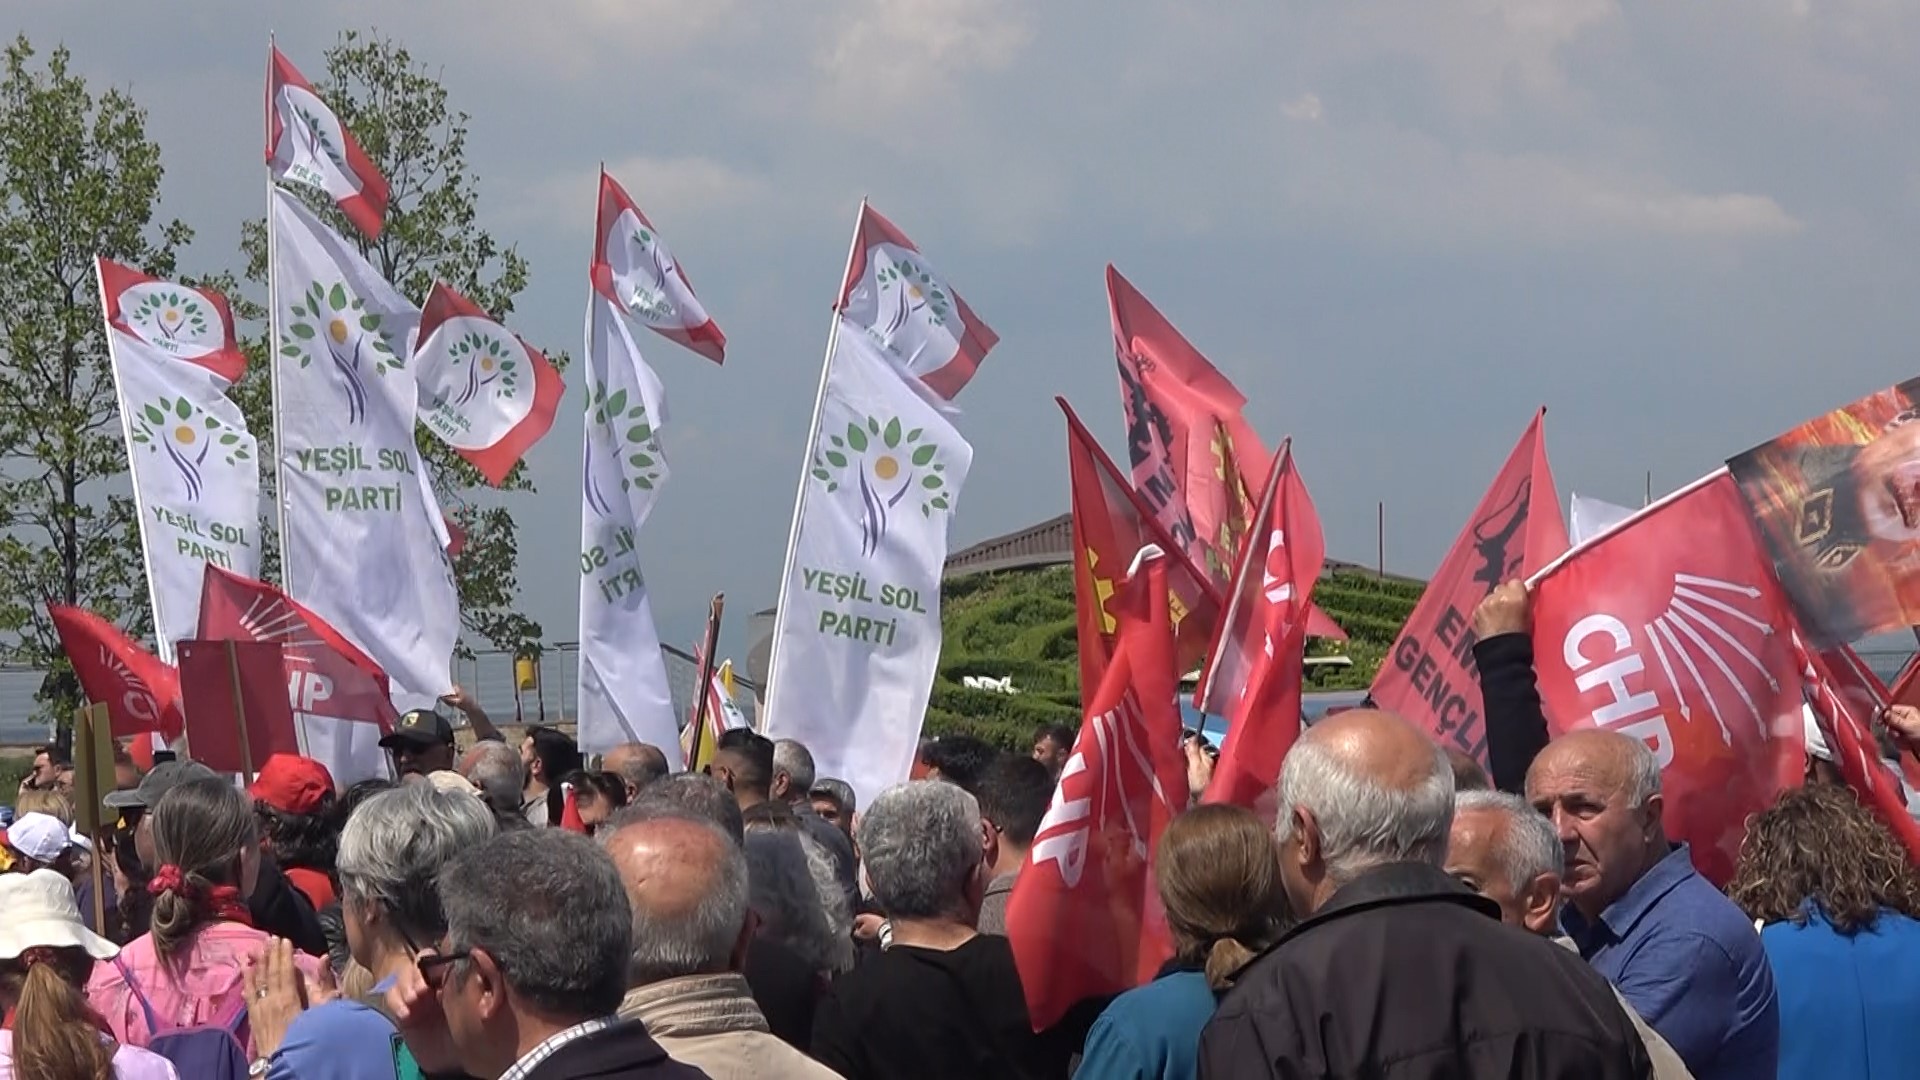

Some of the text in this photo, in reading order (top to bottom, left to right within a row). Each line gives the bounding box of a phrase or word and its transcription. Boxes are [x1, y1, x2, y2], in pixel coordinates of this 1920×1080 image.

[296, 441, 415, 477] YEŞİL SOL
[325, 482, 401, 512] PARTİ
[151, 505, 250, 548] YEŞİL SOL
[803, 567, 927, 614] YEŞİL SOL
[819, 610, 897, 647] PARTİ
[1563, 613, 1675, 770] CHP
